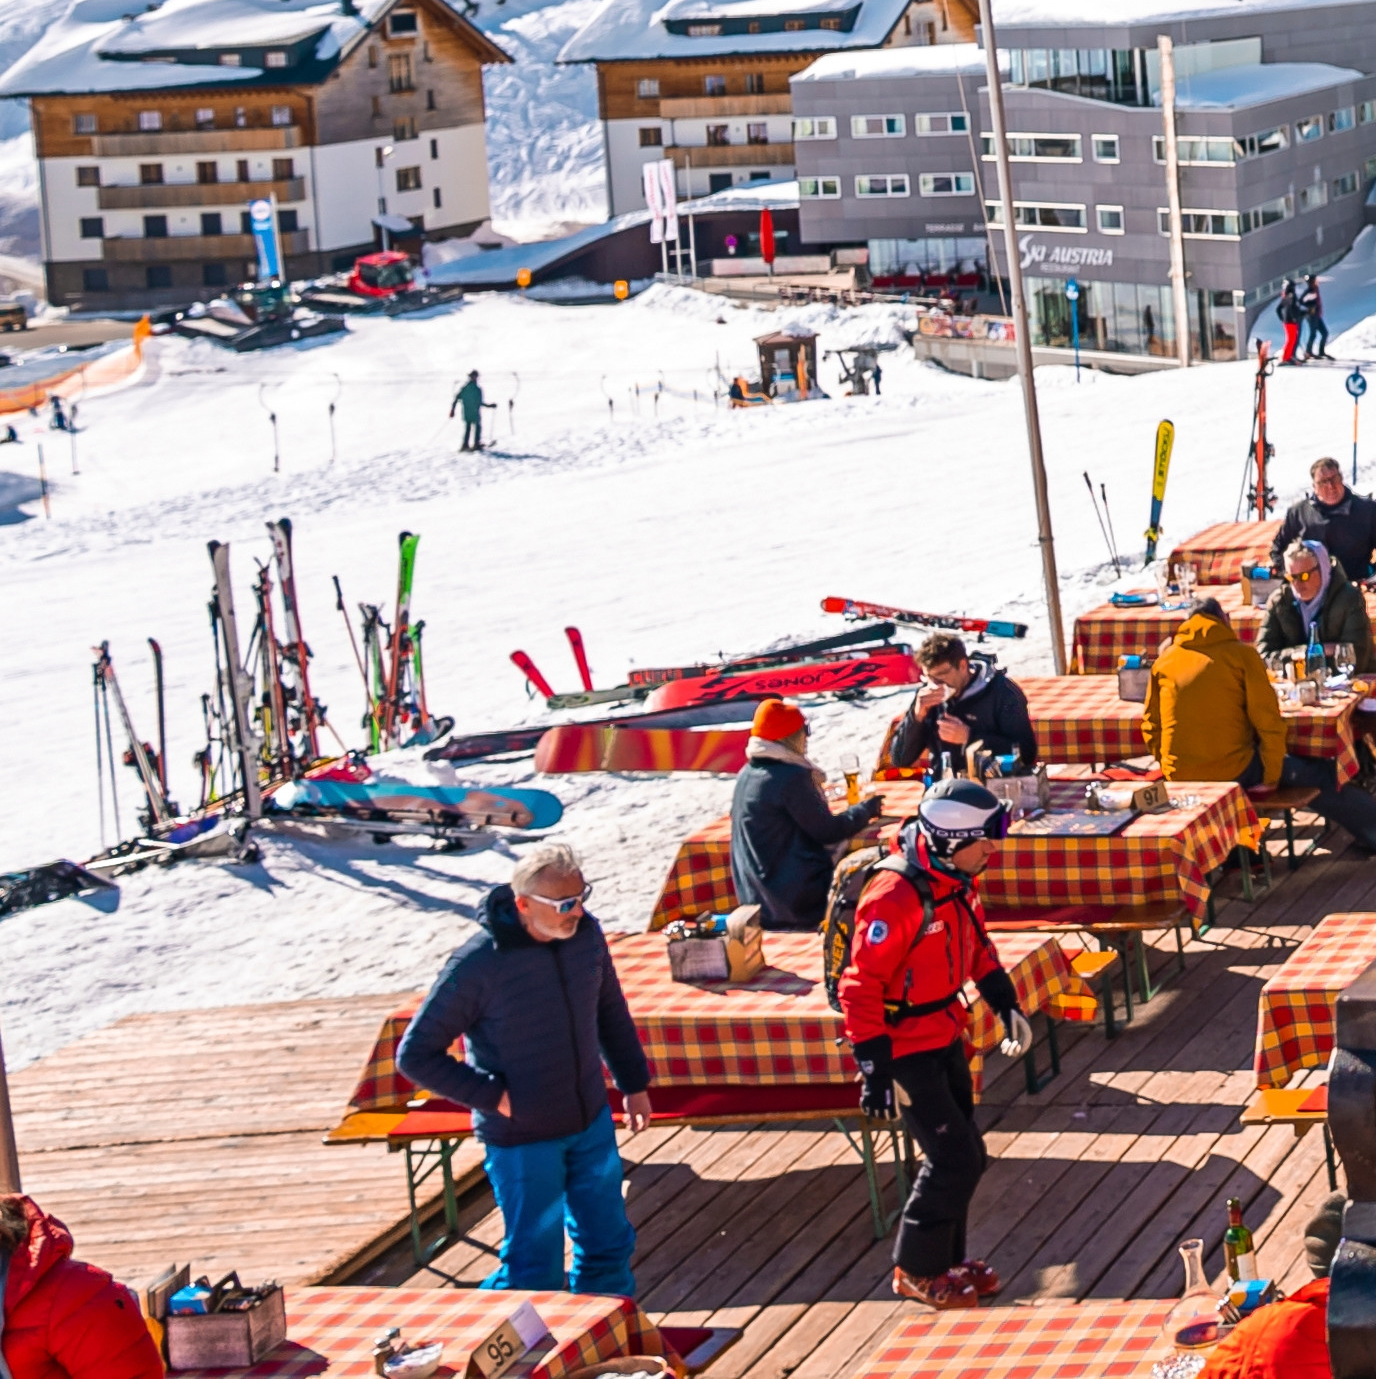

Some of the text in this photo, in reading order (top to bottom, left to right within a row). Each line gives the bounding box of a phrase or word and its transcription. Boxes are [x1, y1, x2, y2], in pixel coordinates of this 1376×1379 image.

[1018, 233, 1114, 270] SKI AUSTRIA
[1143, 786, 1159, 807] 97
[487, 1333, 514, 1367] 95
